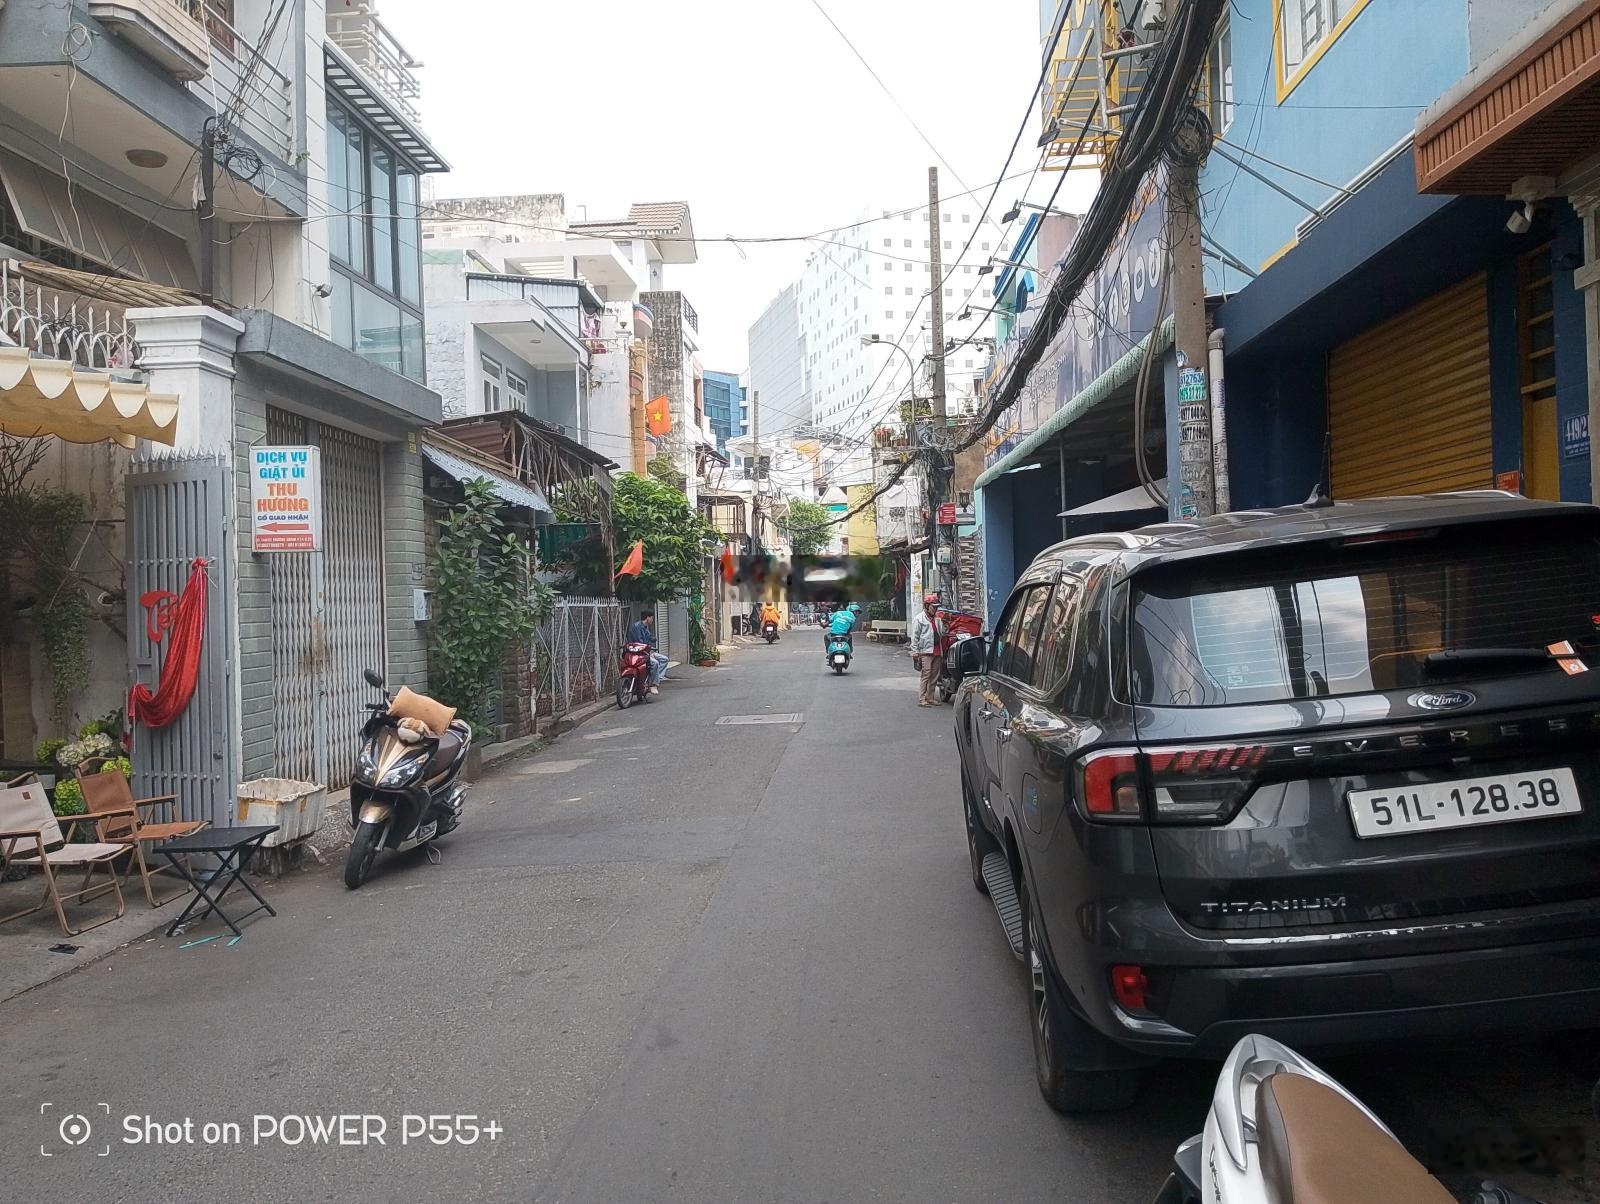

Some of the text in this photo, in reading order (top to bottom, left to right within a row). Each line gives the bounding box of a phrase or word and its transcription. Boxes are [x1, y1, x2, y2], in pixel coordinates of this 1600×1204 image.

[256, 451, 308, 466] DỊCH VỤ
[267, 482, 298, 496] THU
[257, 497, 309, 513] HƯƠNG
[1429, 693, 1463, 706] Ford
[1293, 716, 1600, 757] EVERES
[1370, 777, 1560, 826] 51L-128.38
[1200, 897, 1347, 912] TITANIUM
